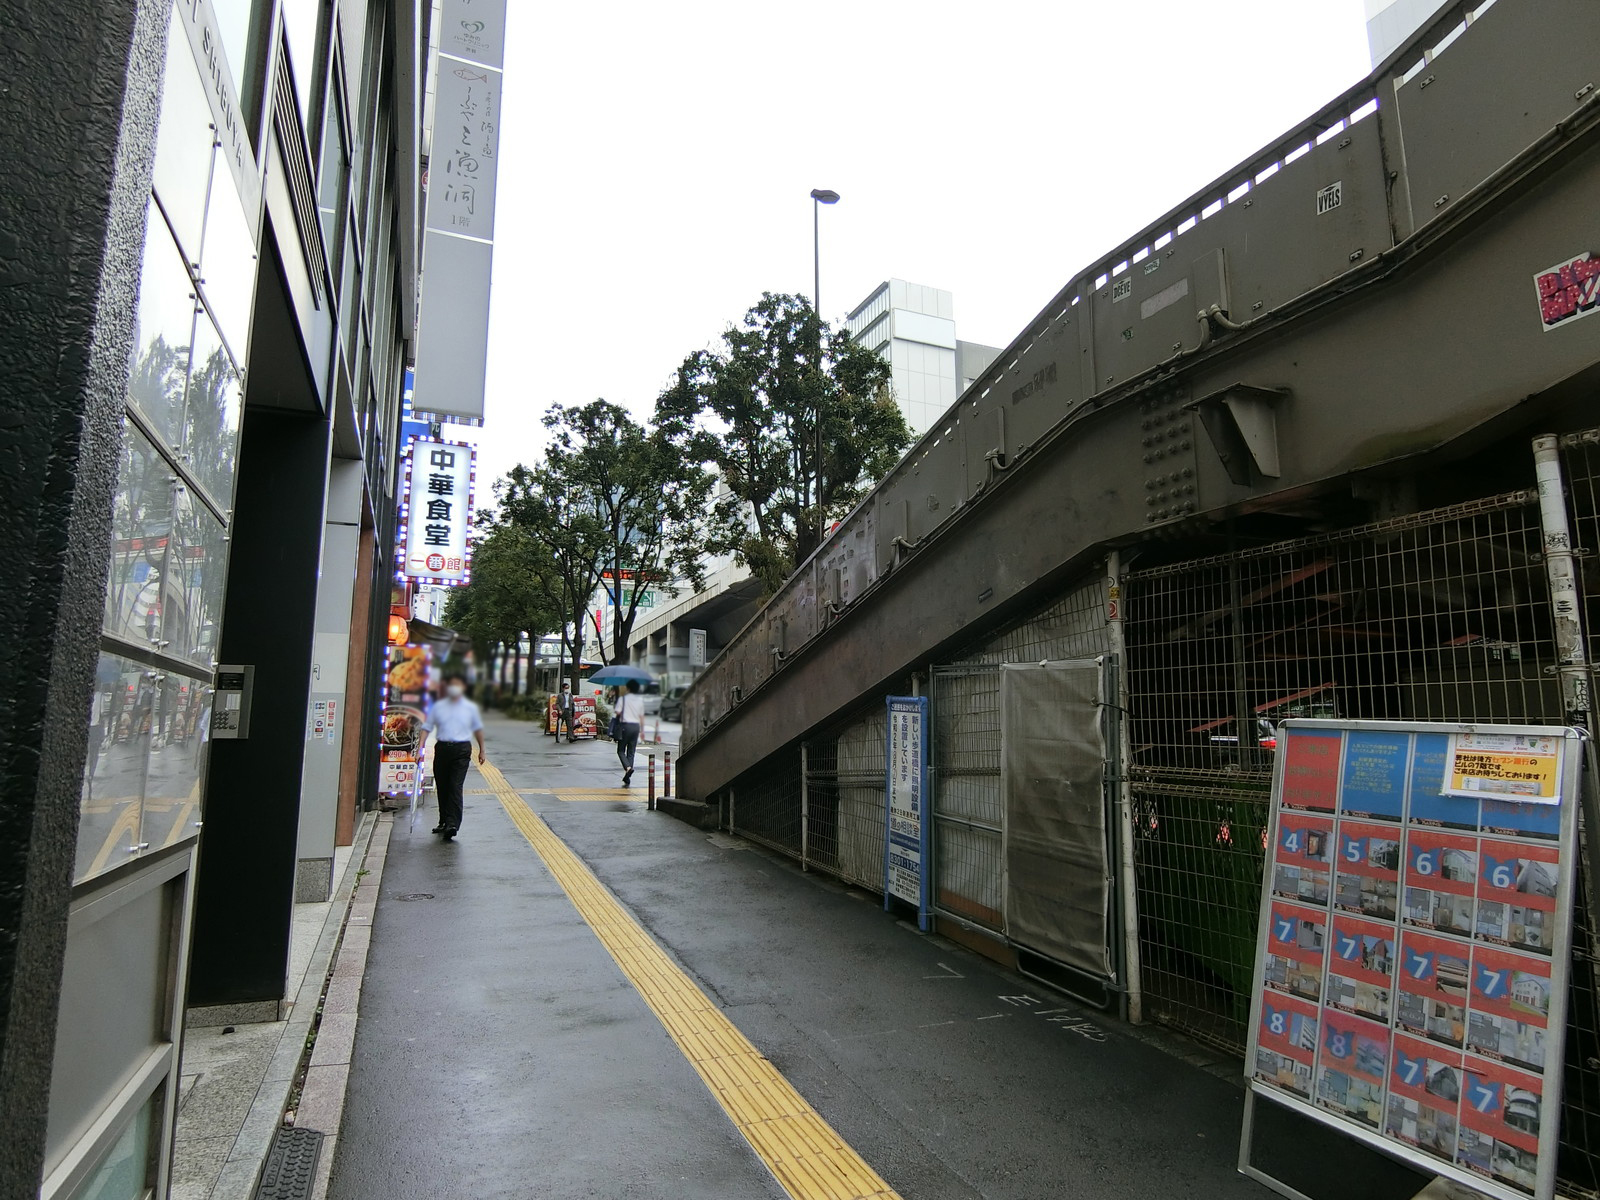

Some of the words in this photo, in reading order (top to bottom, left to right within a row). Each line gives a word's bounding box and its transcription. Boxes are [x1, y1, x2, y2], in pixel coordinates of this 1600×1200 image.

[203, 27, 242, 167] SHIBUYA
[1318, 188, 1340, 212] VYELS
[424, 449, 456, 547] 中華食堂
[410, 553, 461, 571] 一番館
[901, 715, 909, 782] を設置しています
[1285, 833, 1298, 852] 4
[1346, 841, 1360, 862] 5
[1416, 852, 1432, 875] 6
[1492, 865, 1510, 888] 6
[1279, 921, 1291, 940] 7
[1342, 937, 1356, 959] 7
[1413, 956, 1428, 978] 7
[1483, 970, 1500, 994] 7
[1270, 1012, 1283, 1034] 8
[1331, 1034, 1345, 1057] 8
[1404, 1060, 1419, 1083] 7
[1476, 1086, 1493, 1112] 7
